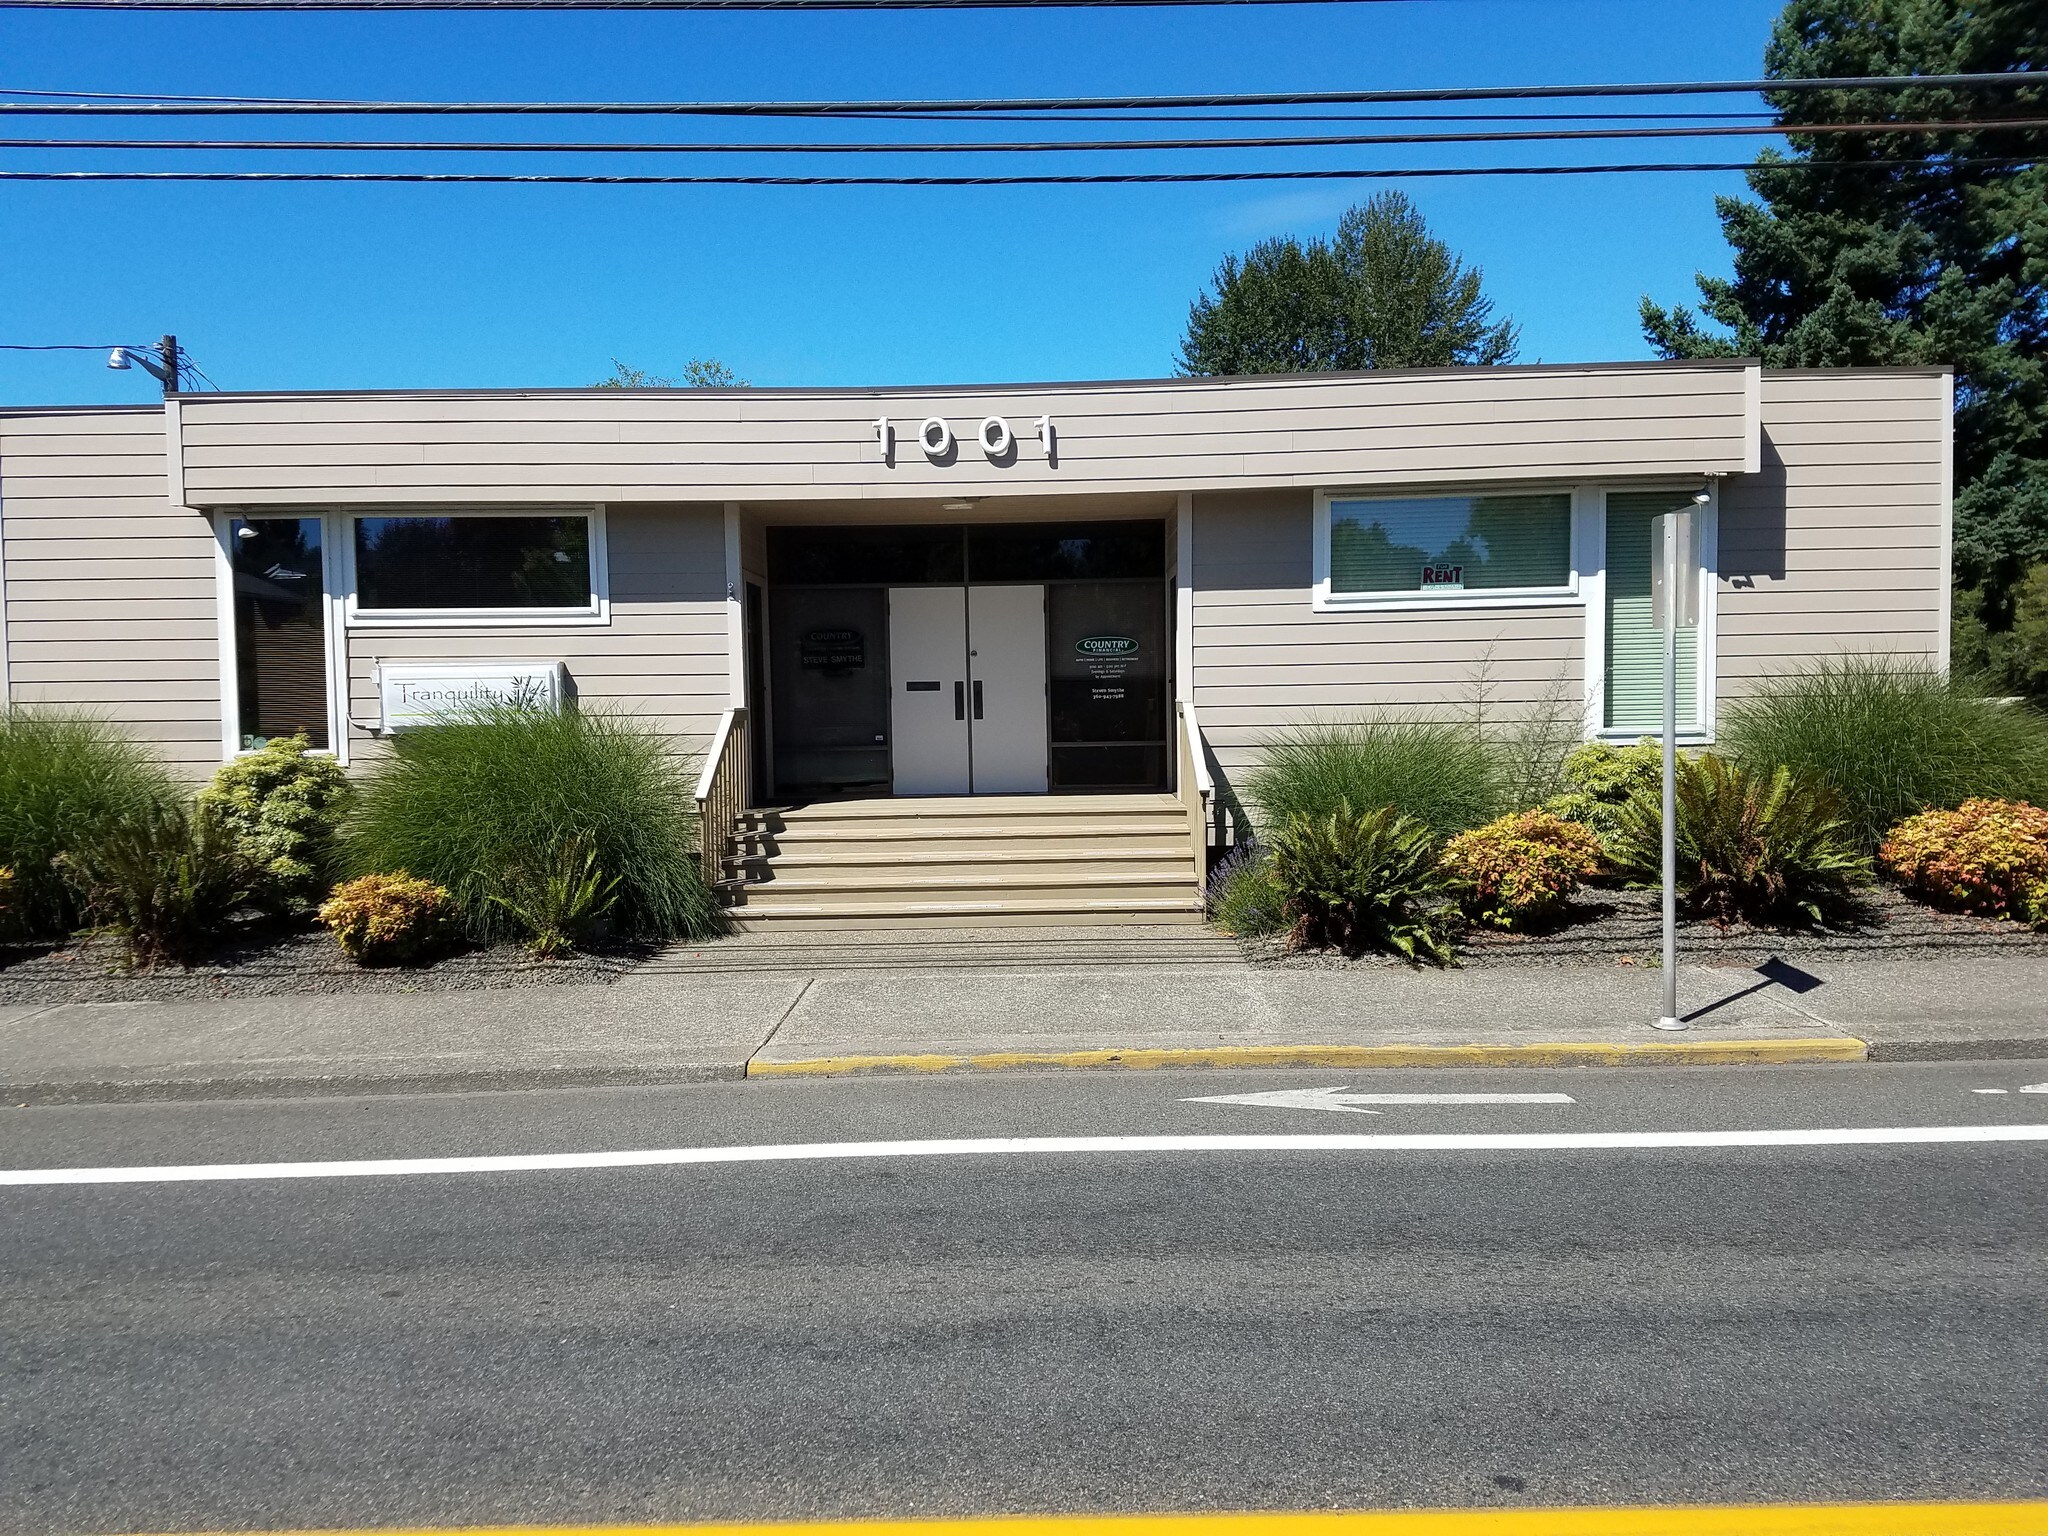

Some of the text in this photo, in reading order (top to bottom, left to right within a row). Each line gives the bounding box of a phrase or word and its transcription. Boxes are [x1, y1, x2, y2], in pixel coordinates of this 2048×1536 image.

[872, 415, 1051, 457] 1001
[1423, 566, 1462, 583] RENT
[810, 631, 852, 640] COUNTRY
[1084, 640, 1130, 649] COUNTRY
[803, 655, 863, 664] STEVE SMYTHE
[394, 681, 503, 707] Tranquility
